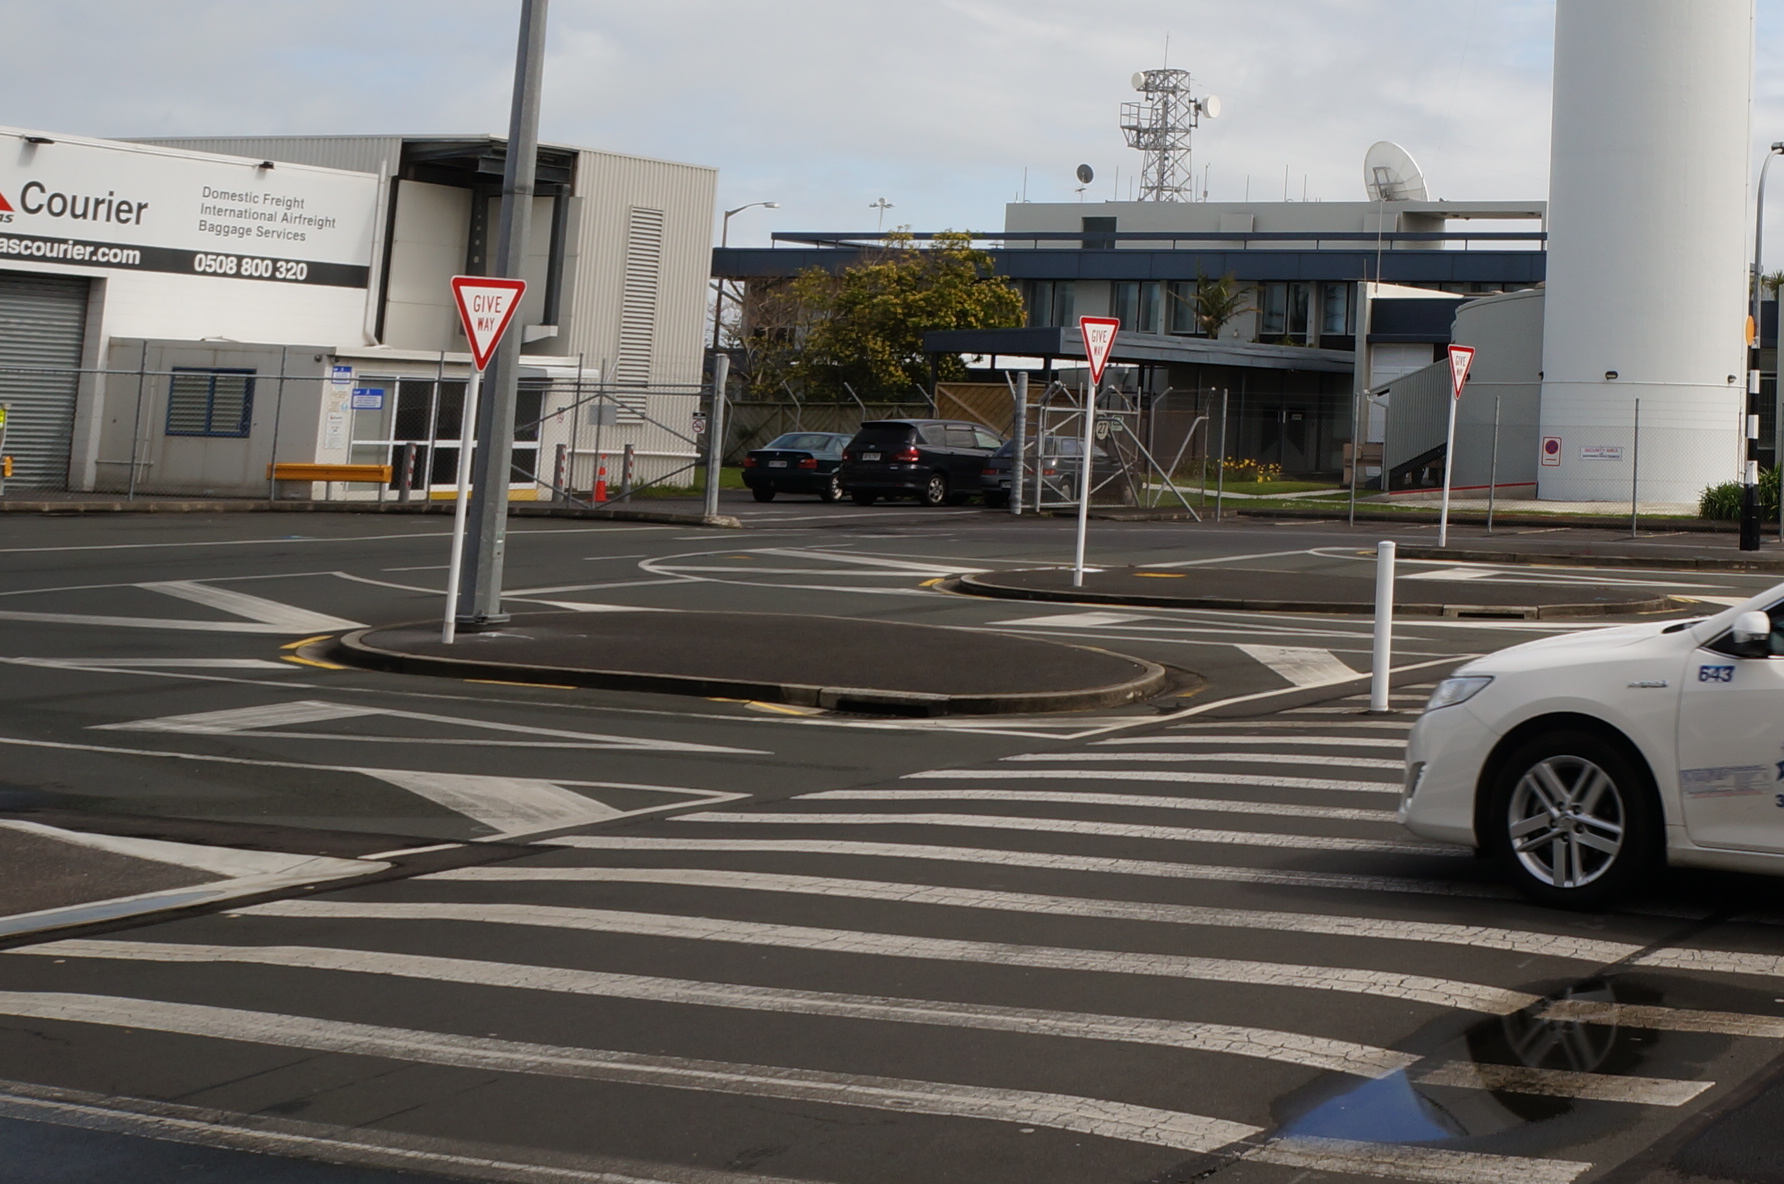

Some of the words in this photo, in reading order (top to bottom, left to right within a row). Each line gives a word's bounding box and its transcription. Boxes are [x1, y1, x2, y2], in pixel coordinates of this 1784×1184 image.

[20, 180, 149, 225] Courier
[202, 186, 259, 204] Domestic
[262, 193, 305, 210] Freight
[200, 202, 278, 222] International
[280, 212, 336, 230] Airfreight
[198, 219, 252, 238] Baggage
[255, 225, 306, 242] Services
[194, 253, 237, 275] 0508
[240, 257, 273, 277] 800
[275, 261, 308, 280] 320
[473, 294, 502, 313] GIVE
[477, 317, 495, 331] WAY
[1091, 329, 1107, 343] GIVE
[1098, 422, 1107, 434] 27
[1698, 665, 1735, 683] 643
